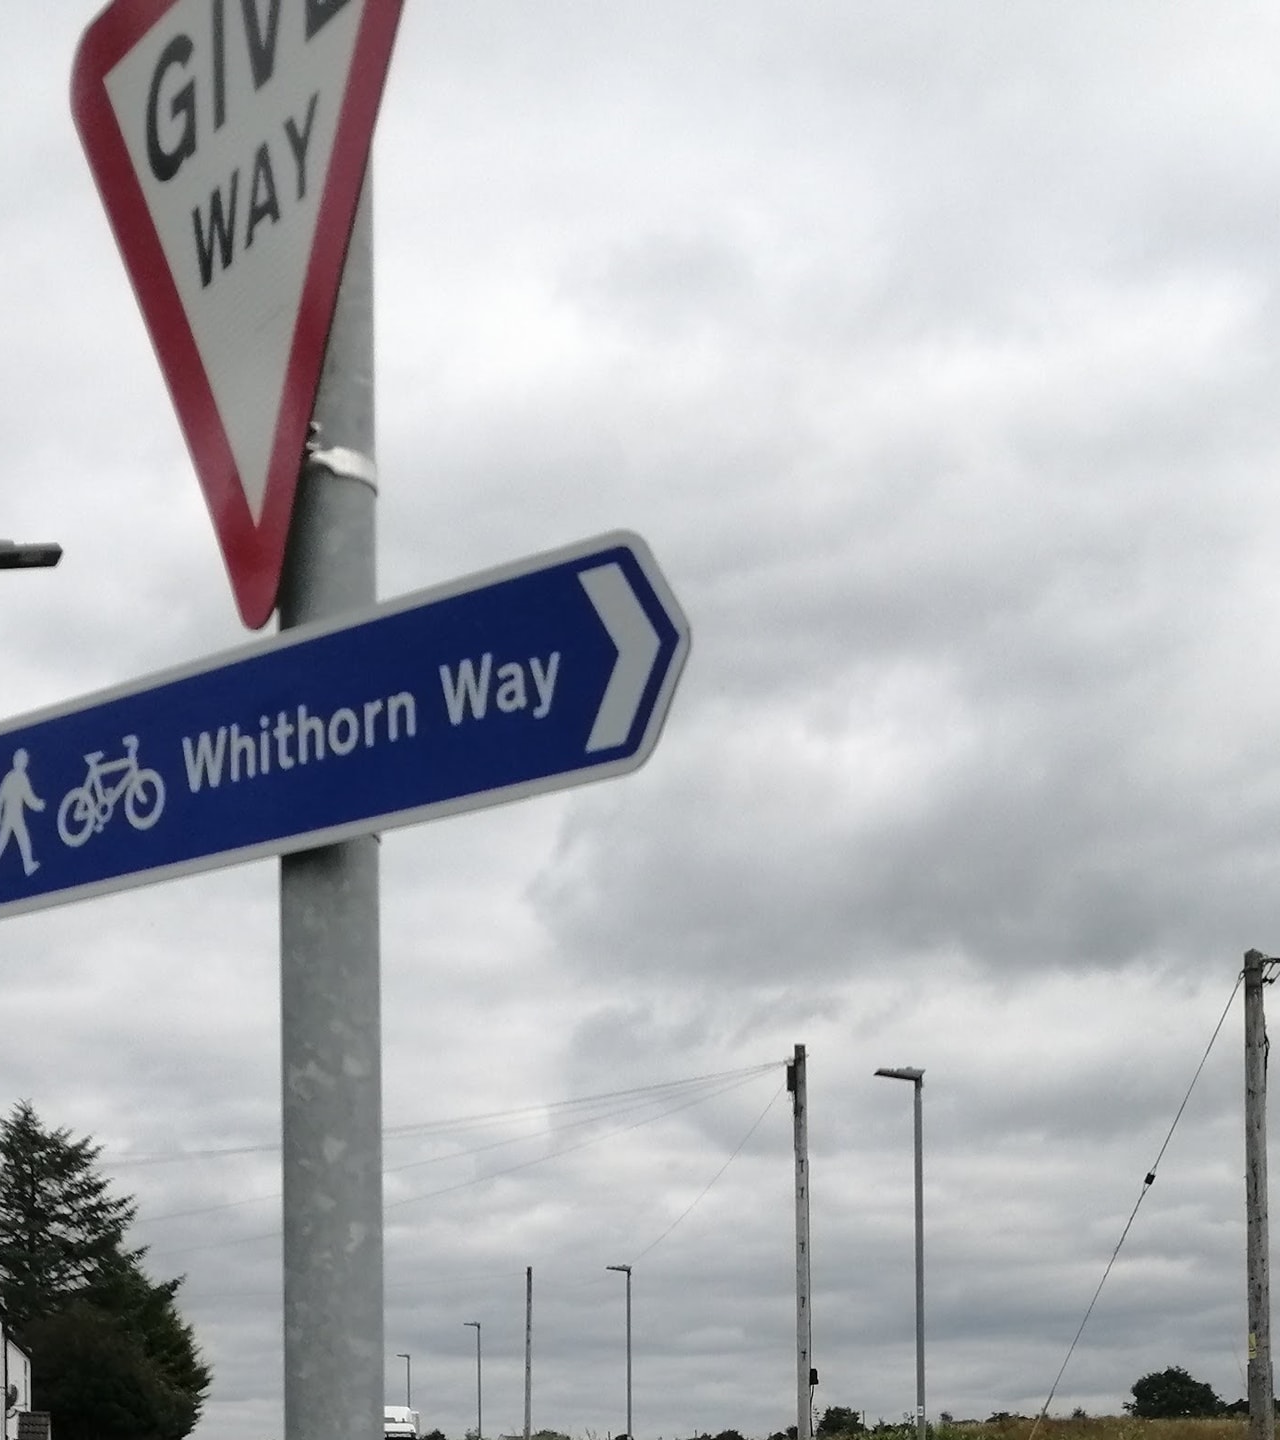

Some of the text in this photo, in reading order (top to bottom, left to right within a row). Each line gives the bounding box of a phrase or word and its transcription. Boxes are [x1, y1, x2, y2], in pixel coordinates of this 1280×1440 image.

[192, 93, 318, 289] WAY
[182, 651, 561, 793] Whithorn Way
